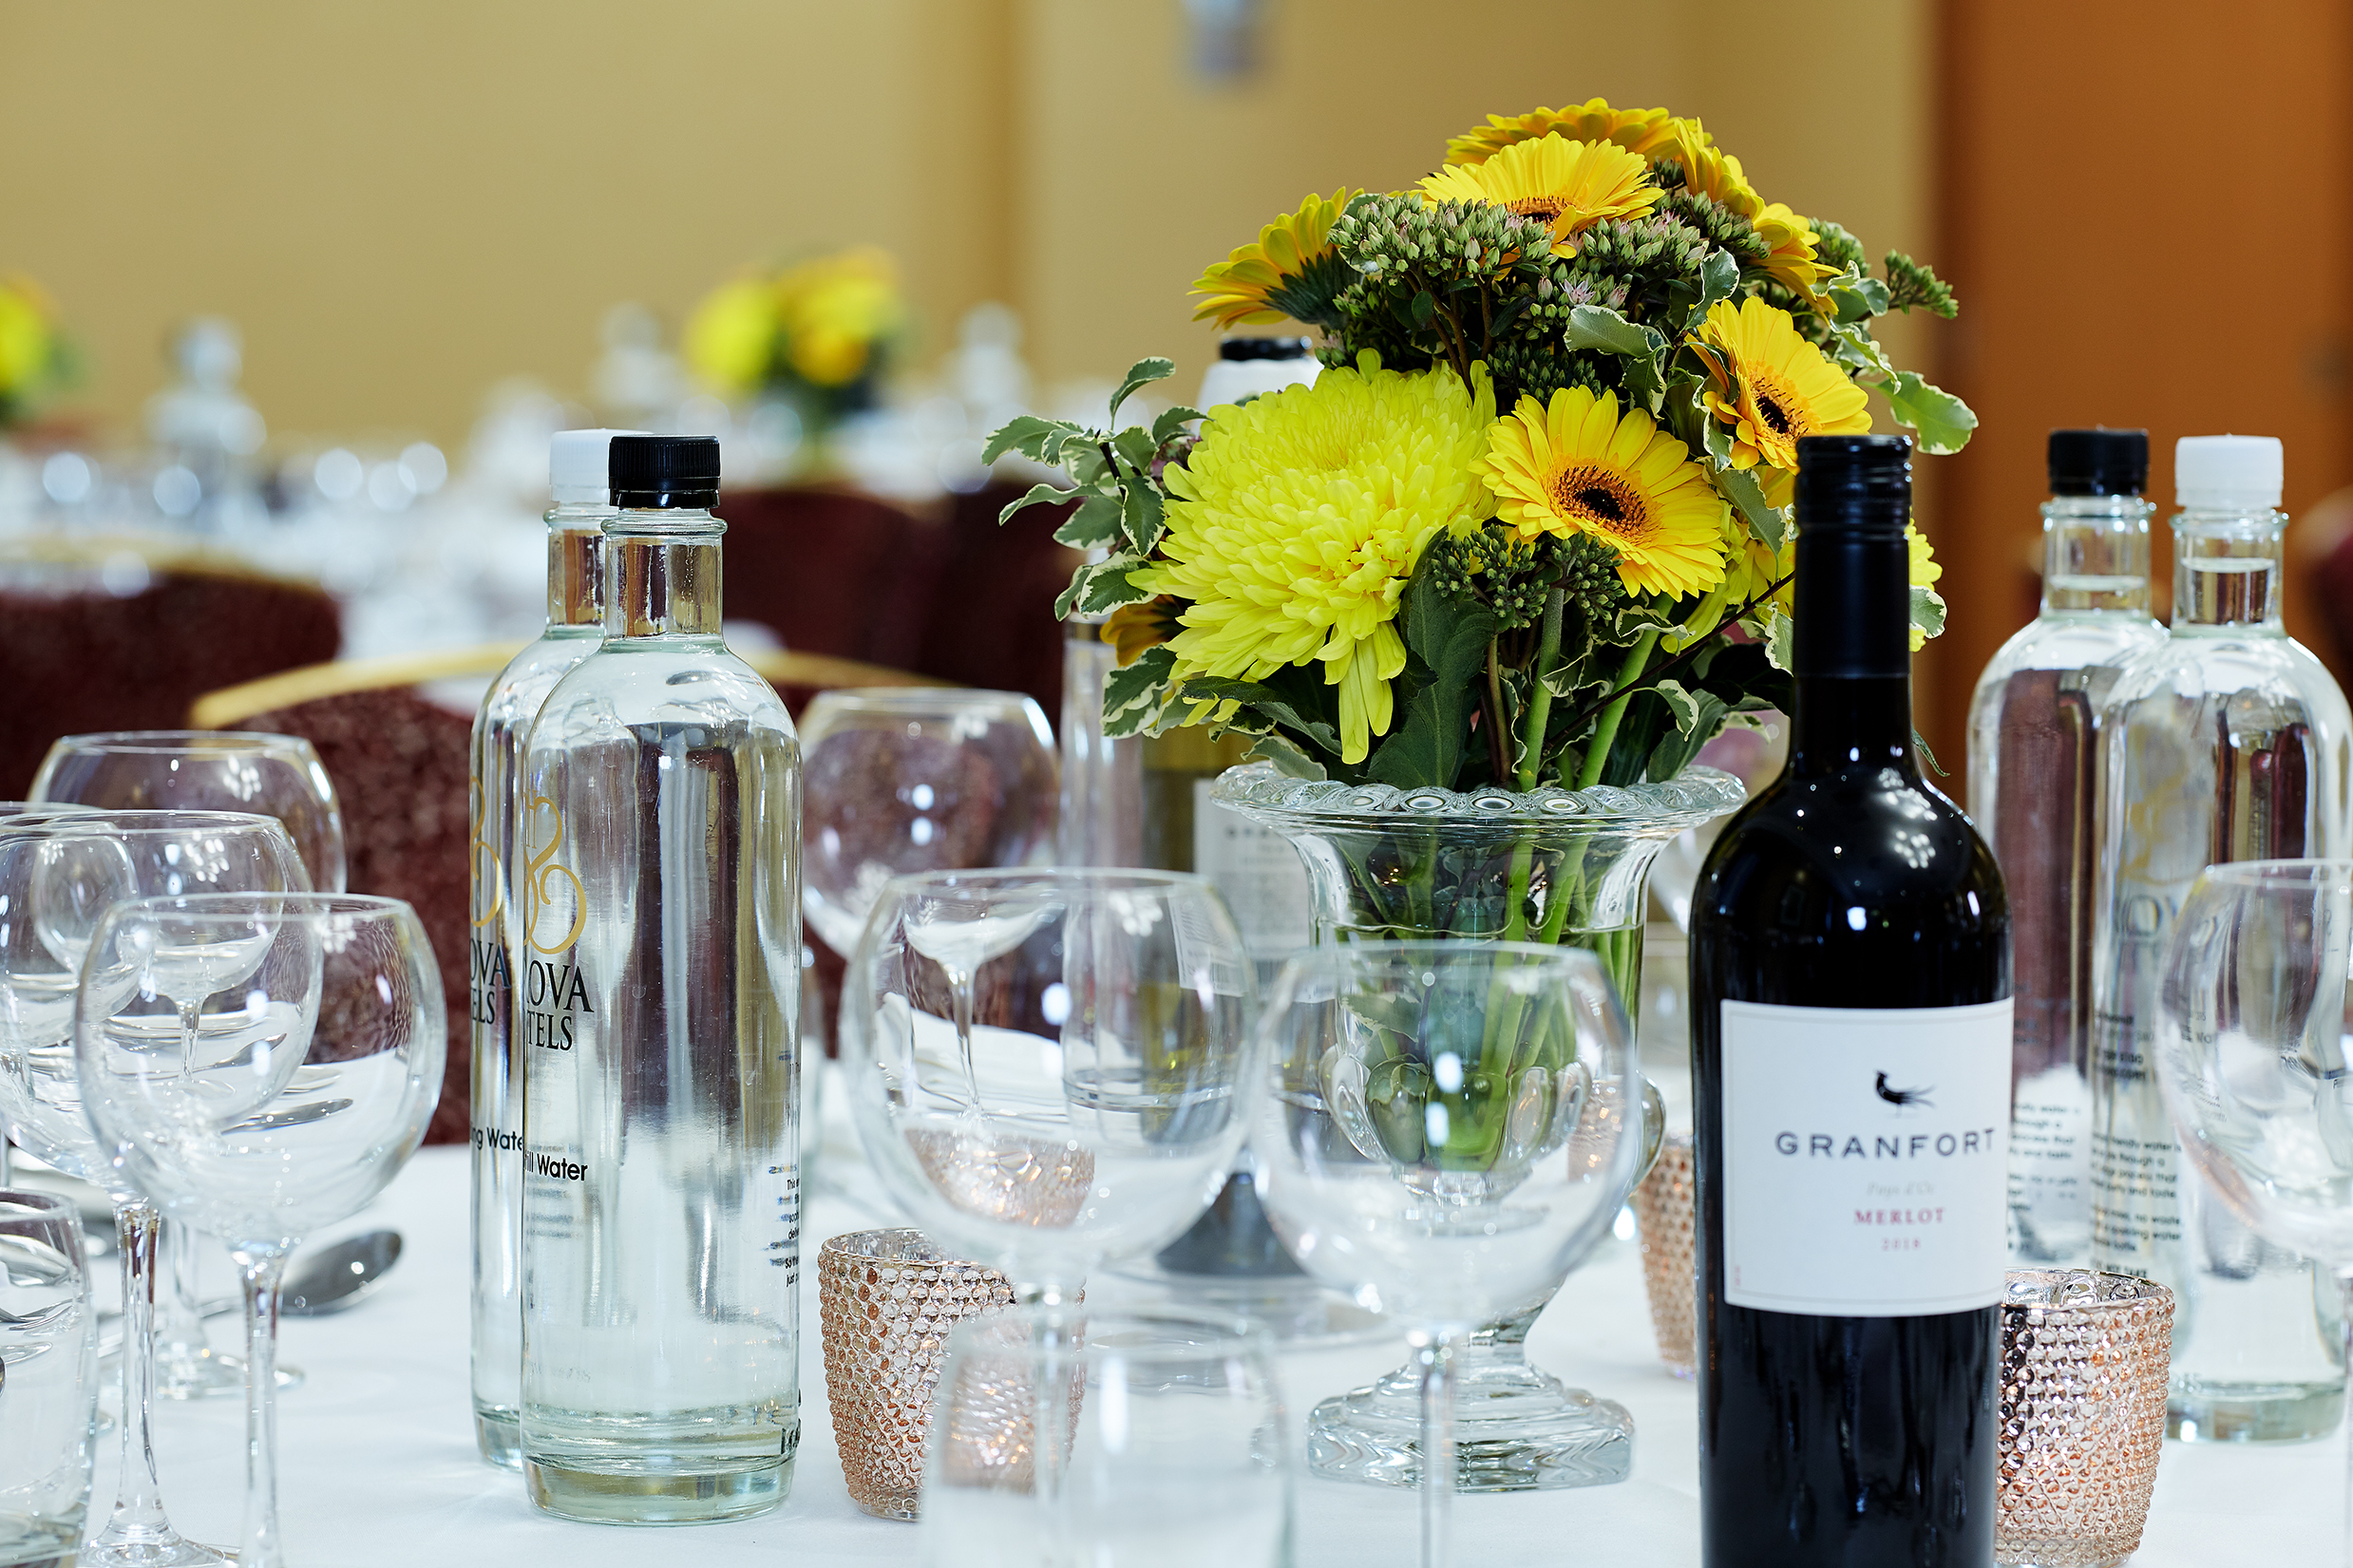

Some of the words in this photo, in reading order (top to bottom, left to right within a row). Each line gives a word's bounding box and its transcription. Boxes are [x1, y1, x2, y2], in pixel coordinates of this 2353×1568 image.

[527, 1010, 573, 1050] TELS
[1774, 1127, 1996, 1159] GRANFORT
[536, 1152, 588, 1181] Water
[1854, 1207, 1945, 1225] MERLOT
